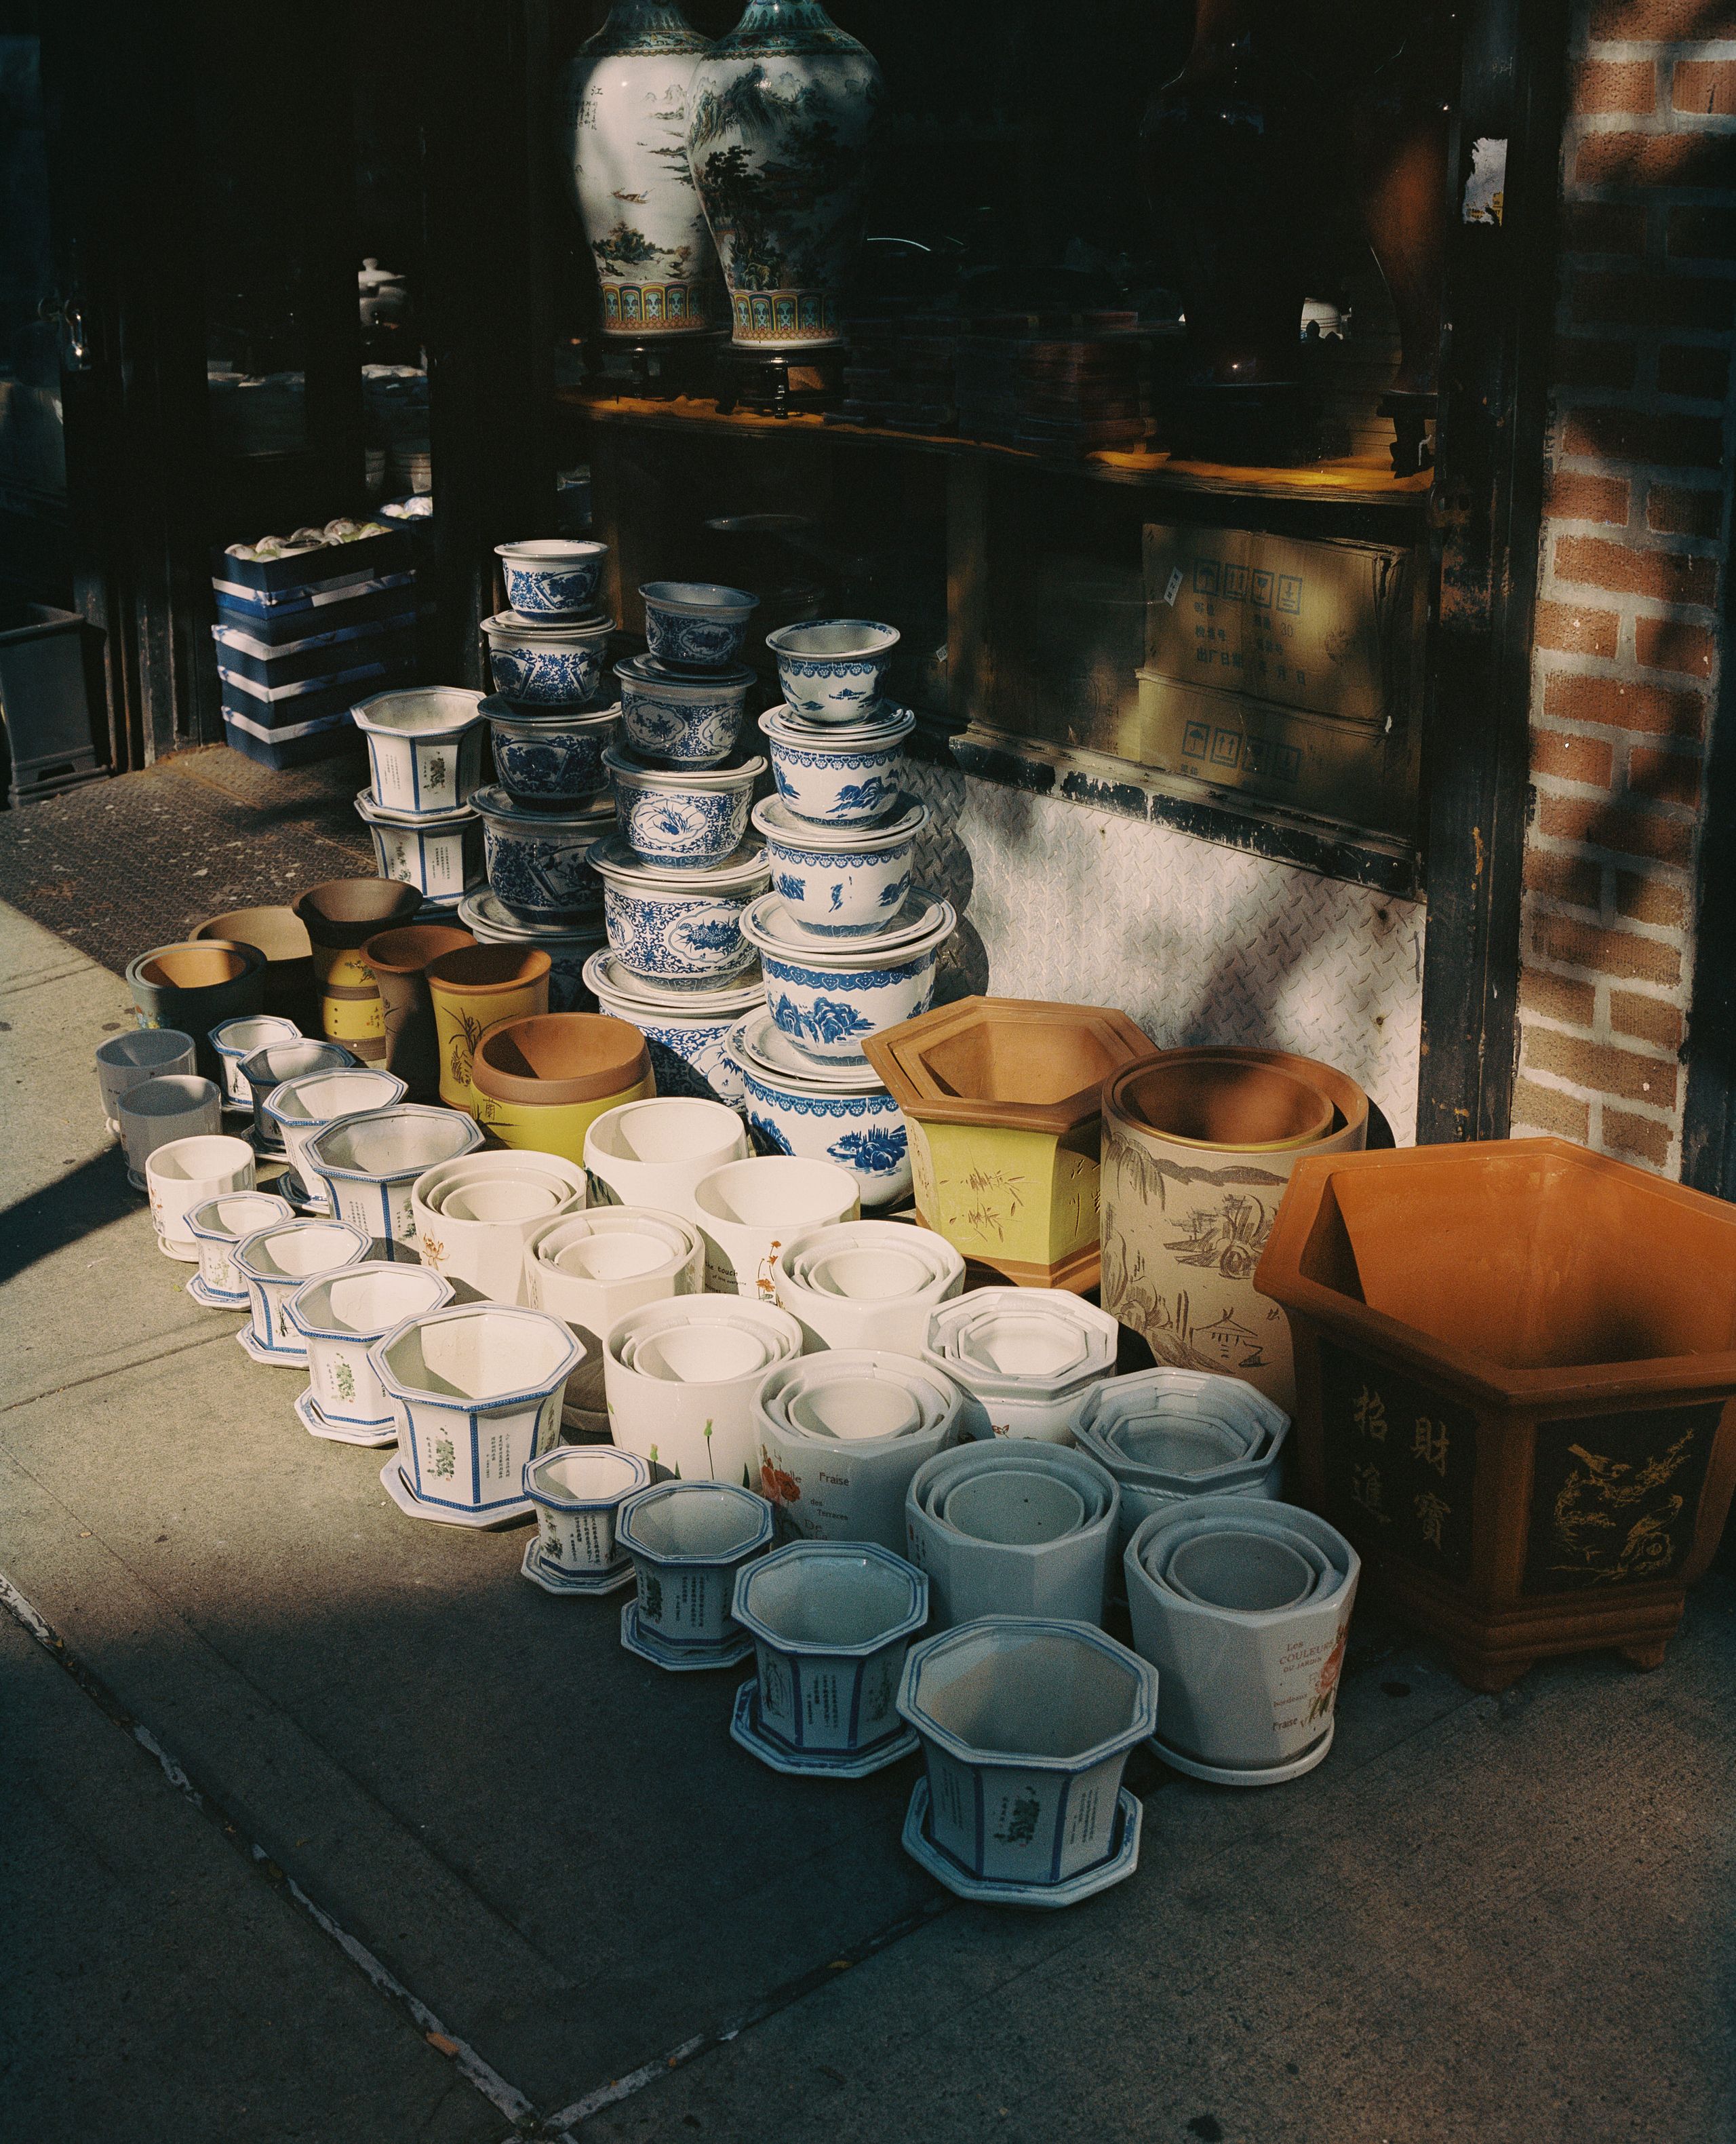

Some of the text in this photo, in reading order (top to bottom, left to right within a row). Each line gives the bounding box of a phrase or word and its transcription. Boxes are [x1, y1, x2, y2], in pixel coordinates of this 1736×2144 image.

[717, 1266, 738, 1276] touch
[818, 1472, 850, 1487] Fraise
[1286, 1640, 1303, 1653] Les
[1297, 1656, 1322, 1669] JARDIN
